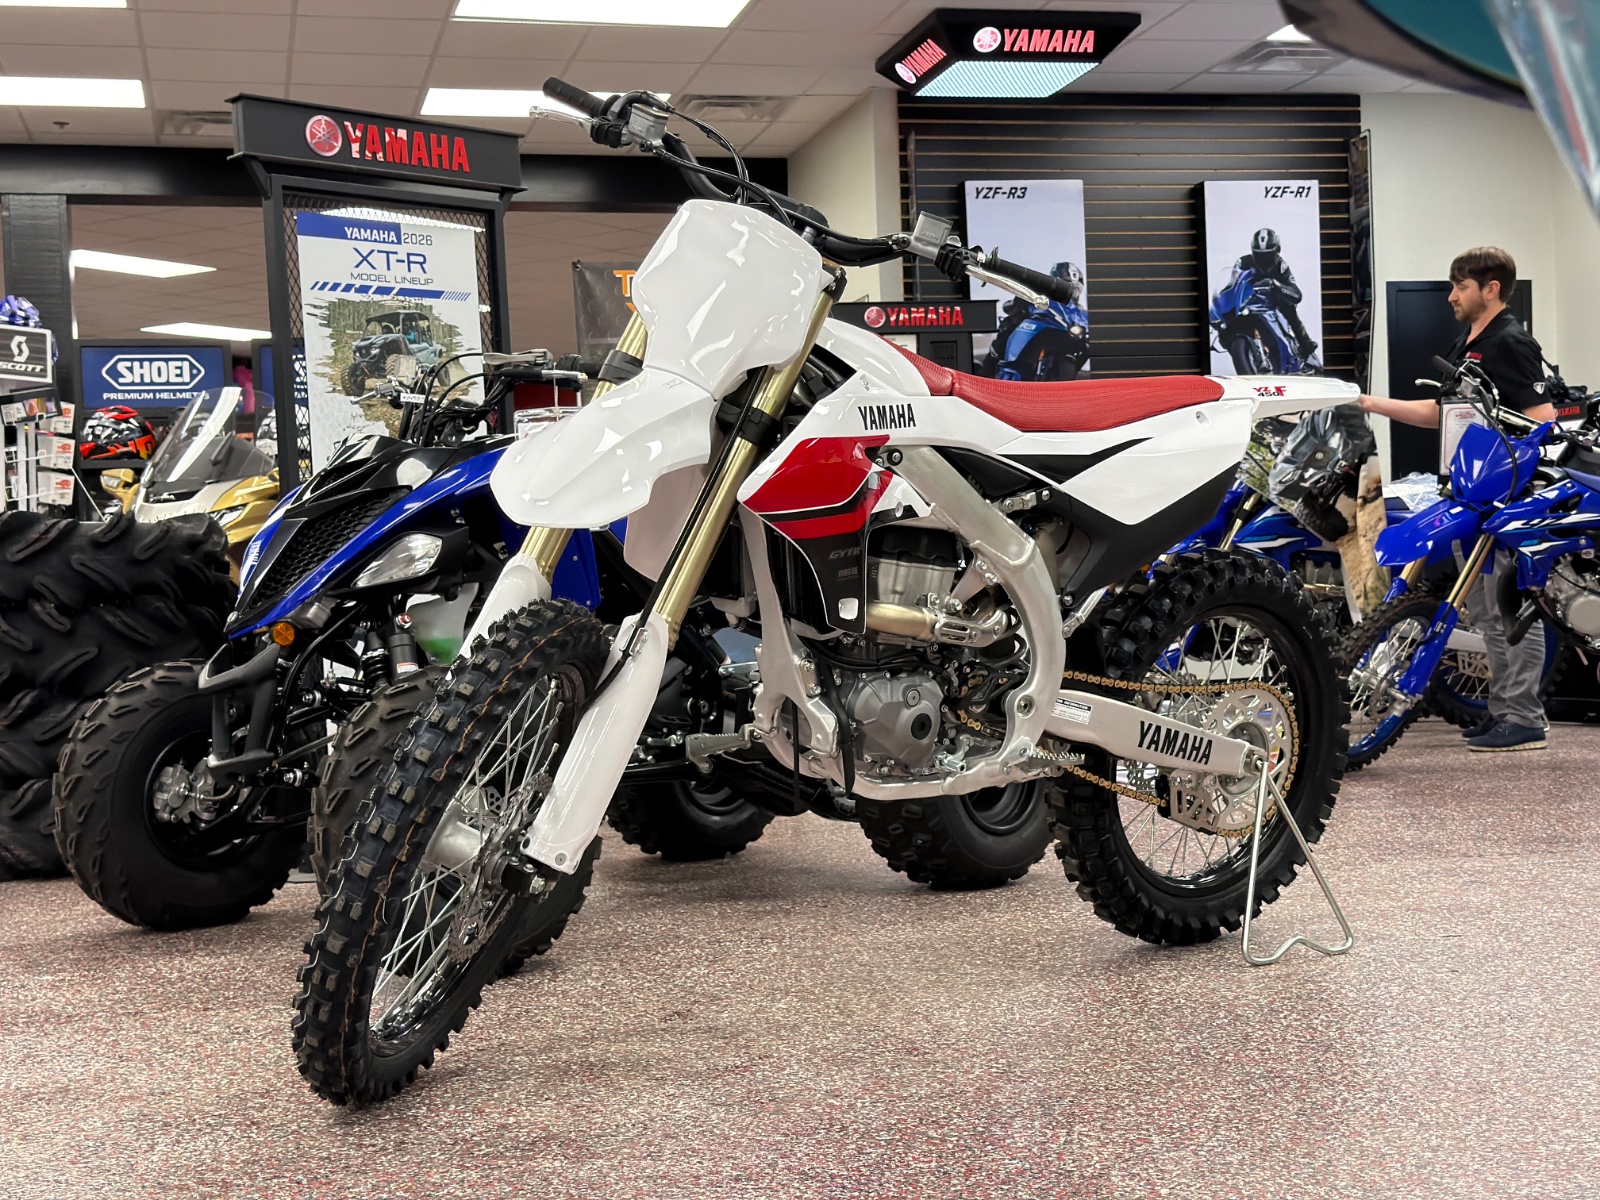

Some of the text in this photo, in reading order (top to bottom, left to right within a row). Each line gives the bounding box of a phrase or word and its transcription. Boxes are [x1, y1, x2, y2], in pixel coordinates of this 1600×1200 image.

[1003, 29, 1095, 52] YAMAHA
[902, 38, 947, 77] YAMAHA
[343, 121, 470, 173] YAMAHA
[975, 187, 1028, 199] YZF-R3
[1264, 186, 1311, 198] YZF-R1
[344, 226, 433, 246] YAMAHA 2026
[353, 247, 428, 274] XT-R
[350, 272, 434, 286] MODEL LINEUP
[886, 306, 964, 327] YAMAHA
[0, 362, 44, 372] SCOTT
[117, 360, 190, 383] SHOEI
[103, 392, 154, 400] PREMIUM
[857, 403, 917, 431] YAMAHA
[1137, 720, 1213, 765] YAMAHA
